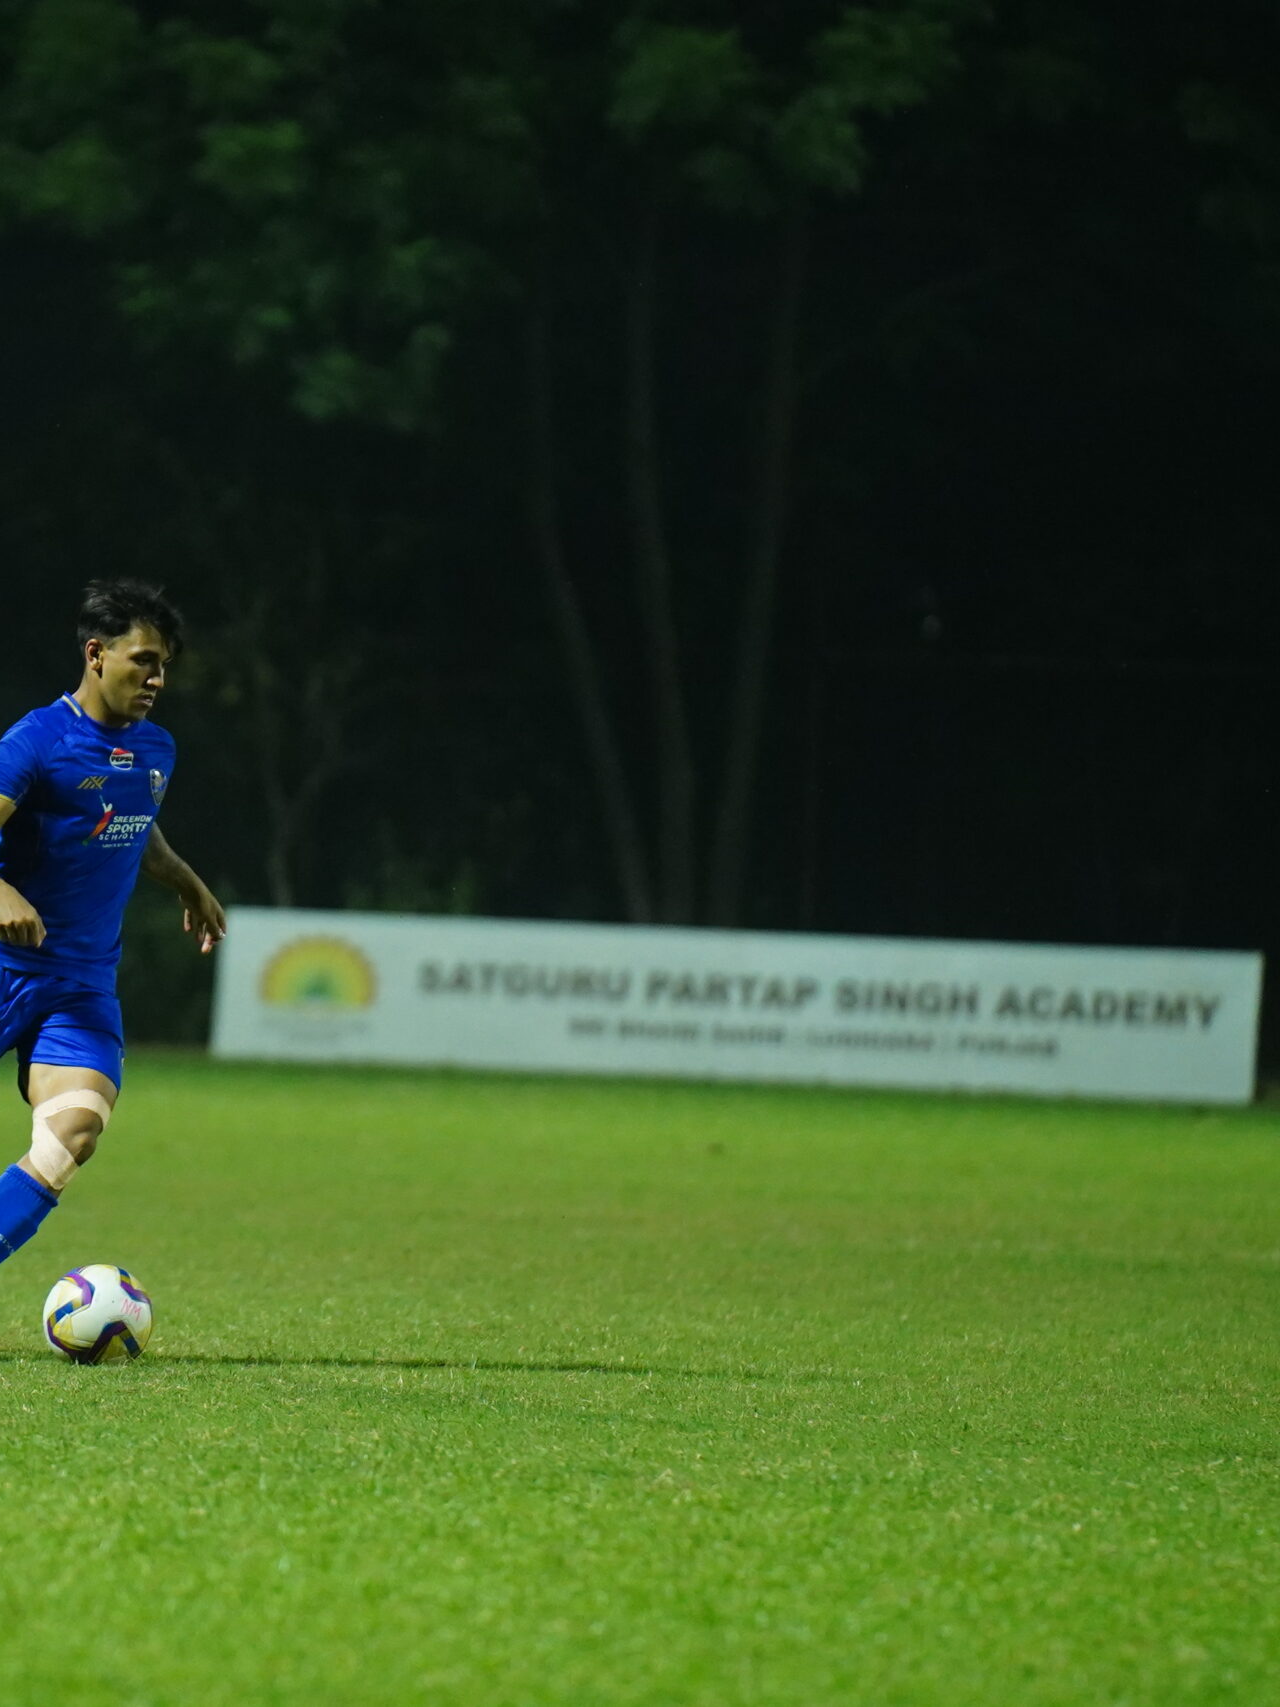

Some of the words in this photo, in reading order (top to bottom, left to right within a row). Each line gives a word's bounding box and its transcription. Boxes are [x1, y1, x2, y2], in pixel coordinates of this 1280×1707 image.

[643, 970, 821, 1012] PARTAP
[832, 978, 980, 1018] SINGH
[993, 984, 1223, 1030] ACADEMY
